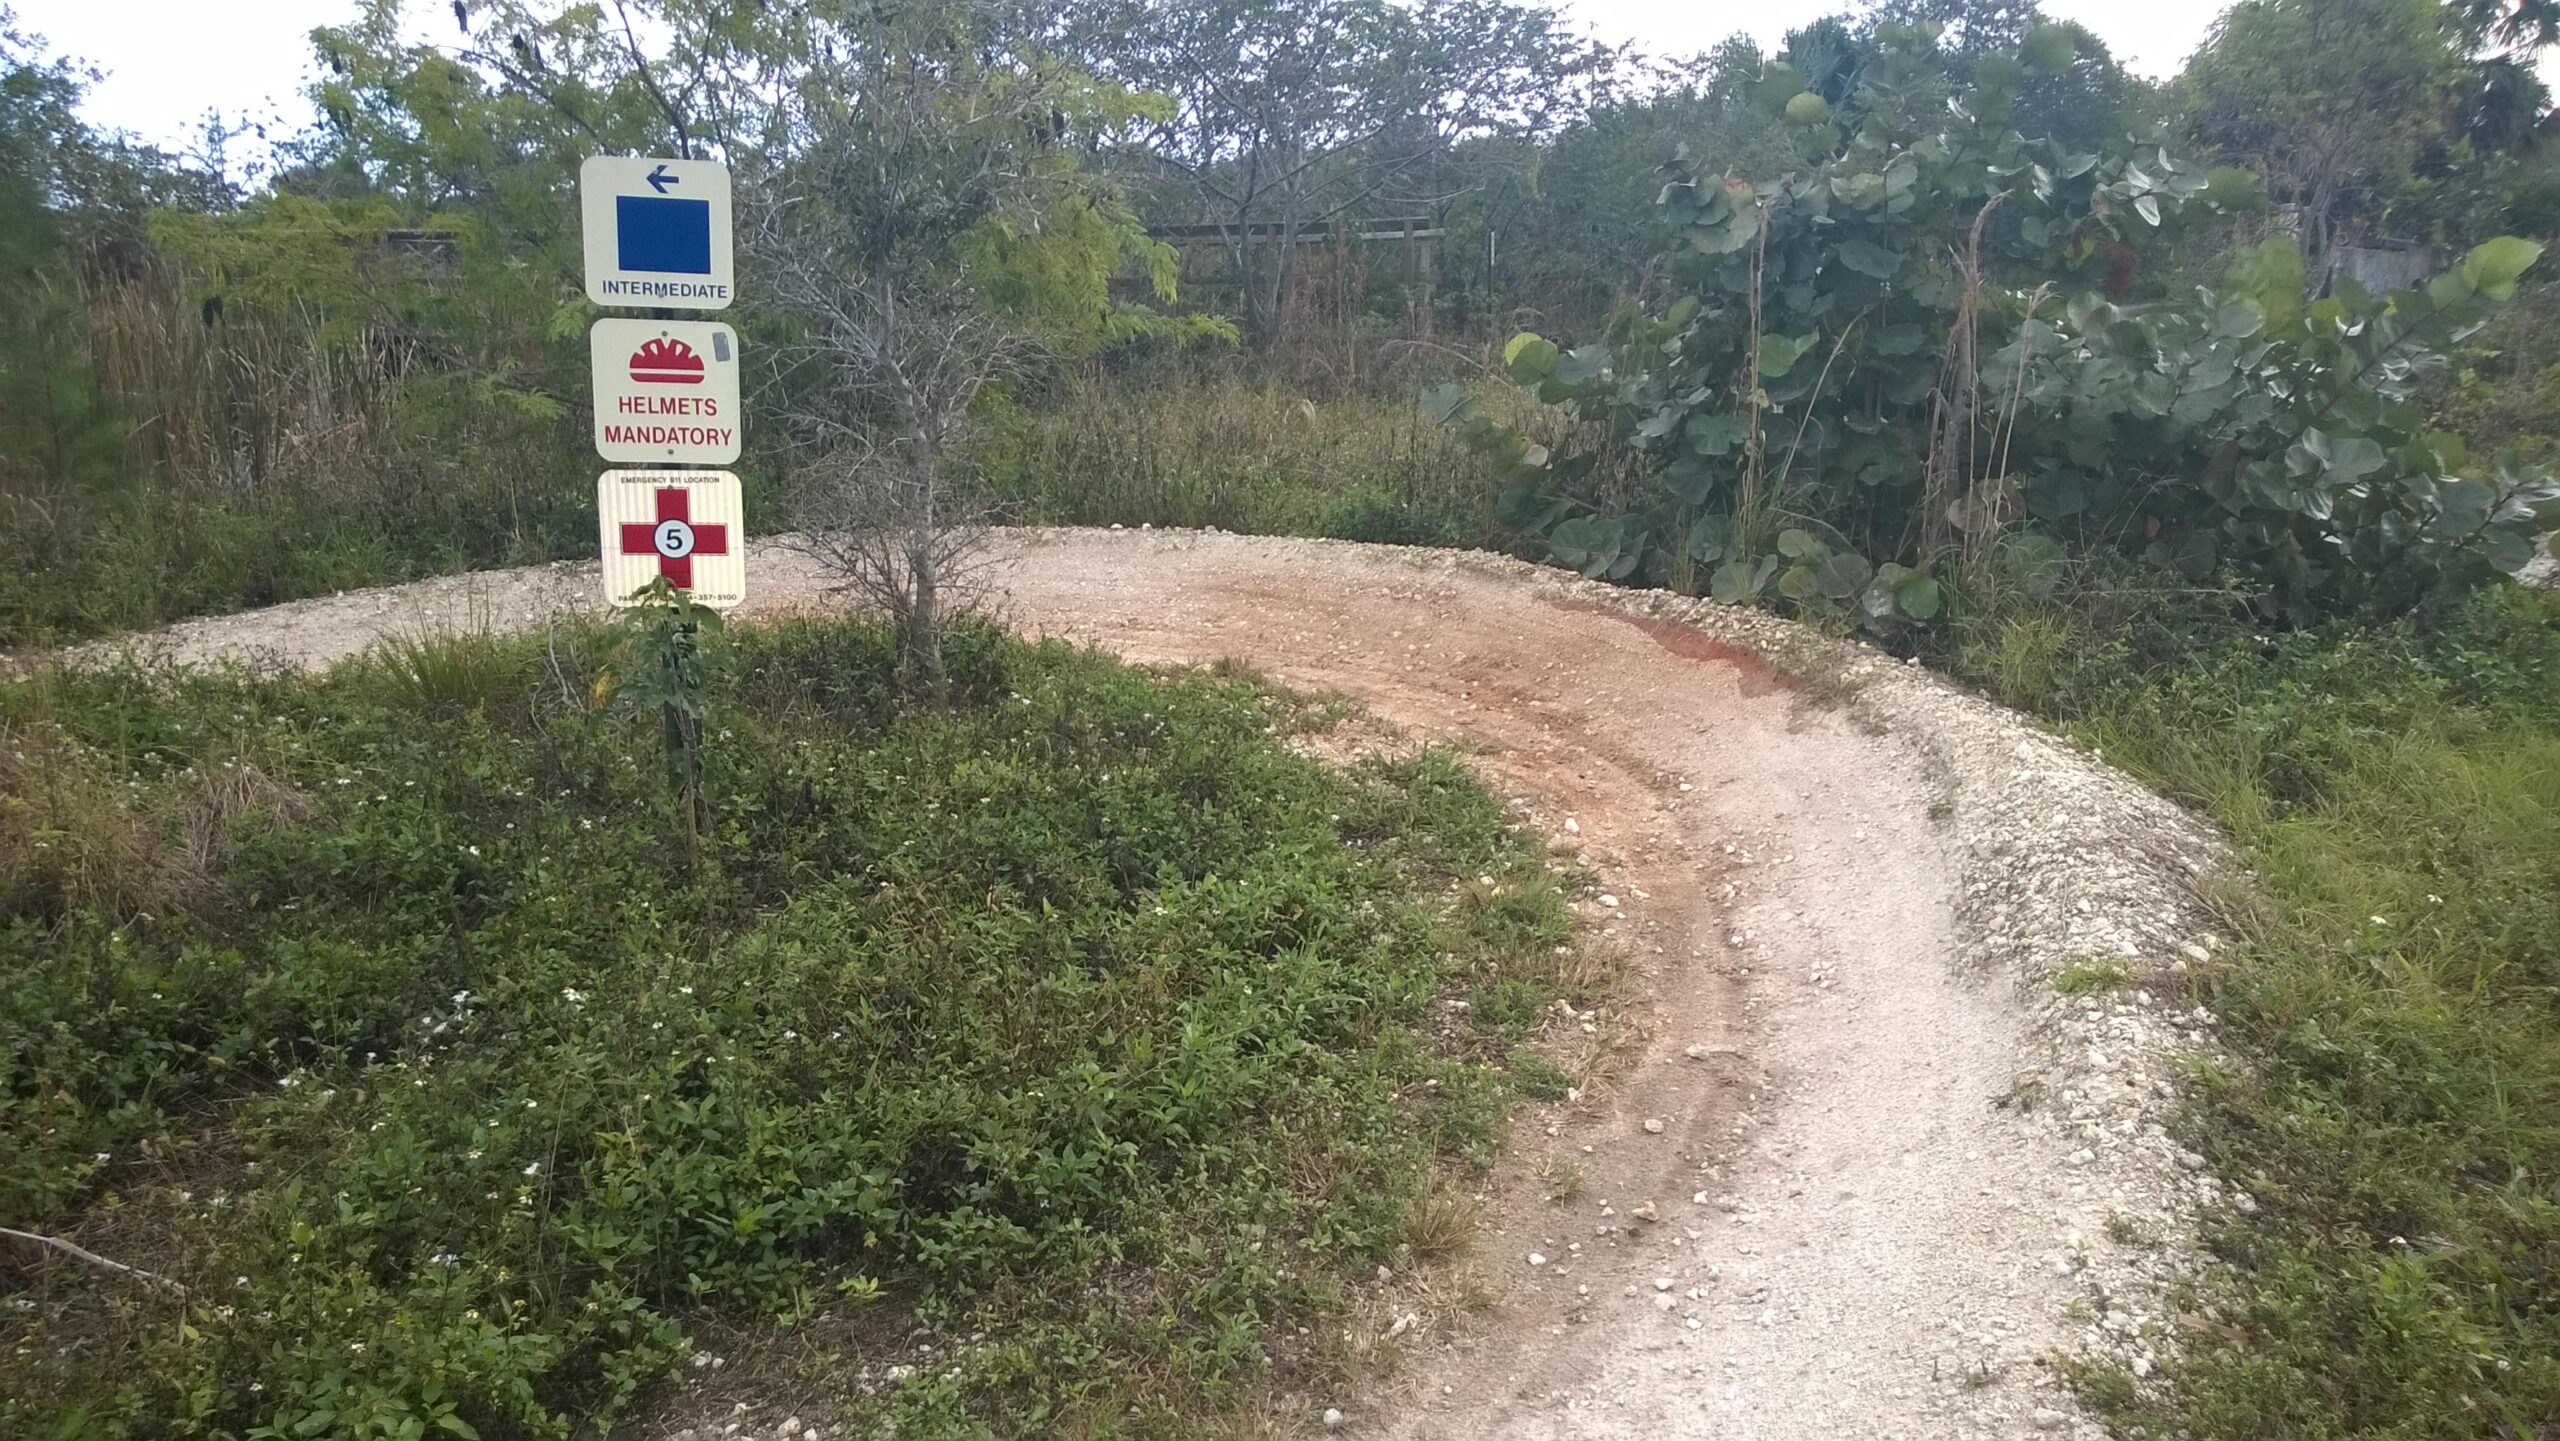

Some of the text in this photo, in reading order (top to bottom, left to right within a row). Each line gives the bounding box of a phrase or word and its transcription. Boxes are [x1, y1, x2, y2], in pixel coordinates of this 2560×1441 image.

[603, 280, 727, 298] INTERMEDIATE
[619, 396, 718, 416] HELMETS
[605, 426, 732, 446] MANDATORY
[666, 529, 683, 550] 5
